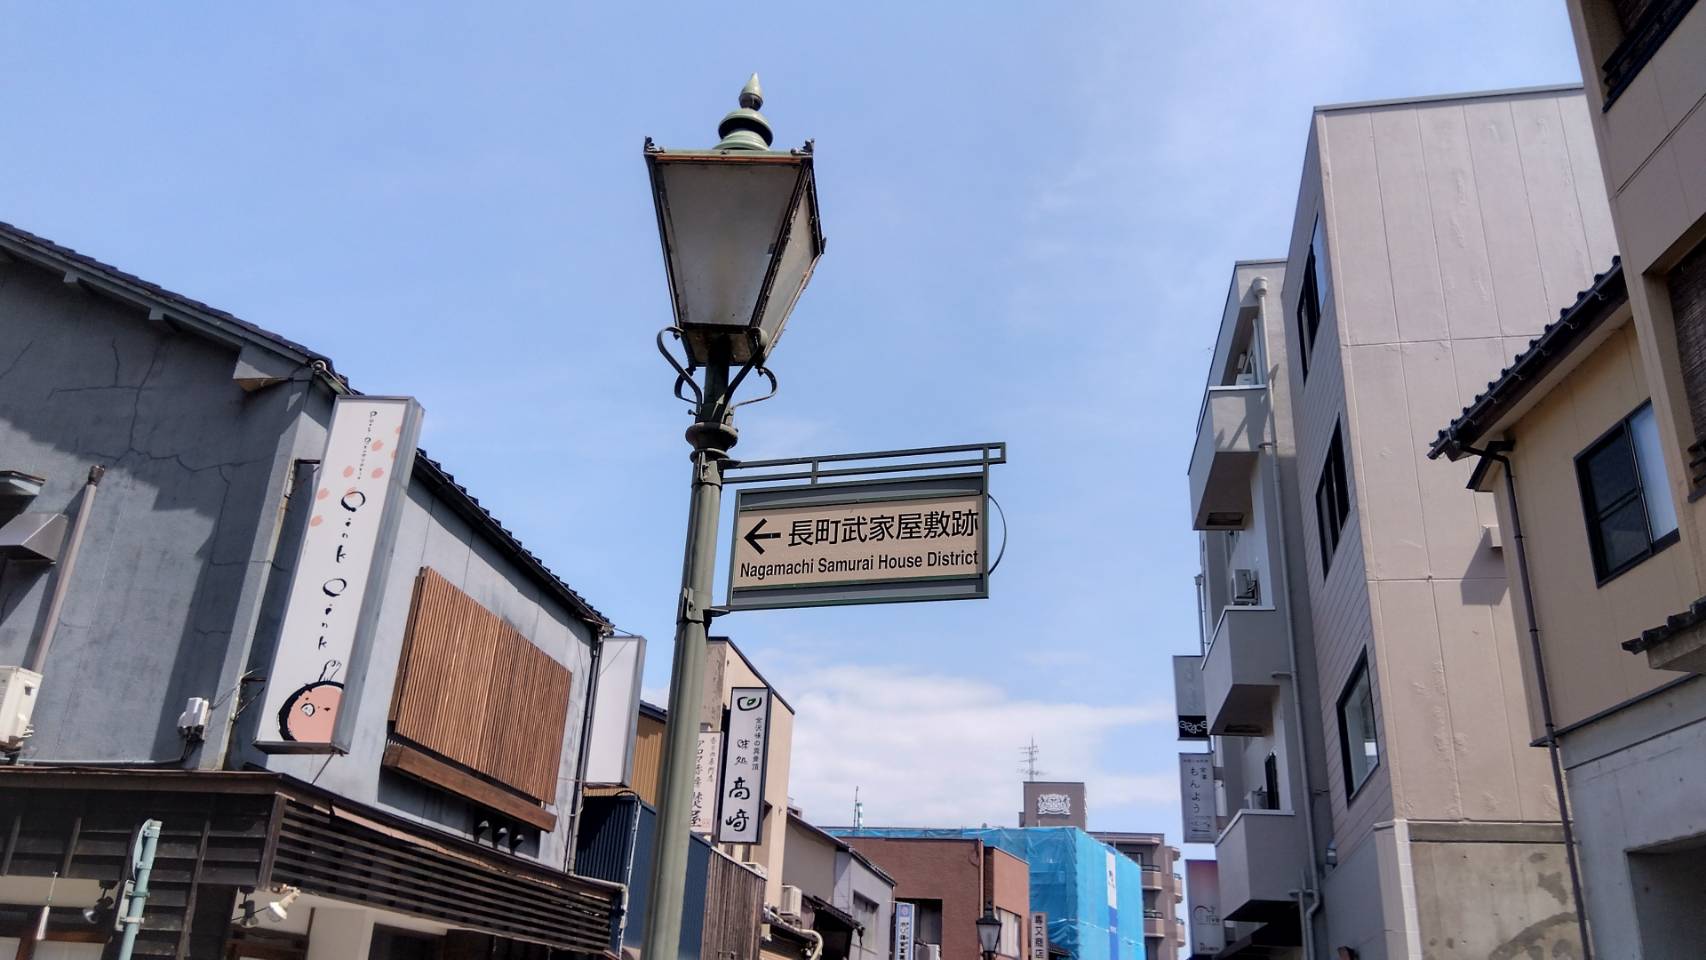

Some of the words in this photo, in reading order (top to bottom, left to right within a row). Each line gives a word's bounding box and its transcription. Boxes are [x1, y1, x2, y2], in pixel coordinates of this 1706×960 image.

[787, 509, 979, 548] 長町武家屋敷跡
[740, 559, 814, 580] Nagamachi
[817, 554, 874, 573] Samurai
[878, 551, 921, 570] House
[927, 549, 979, 567] District
